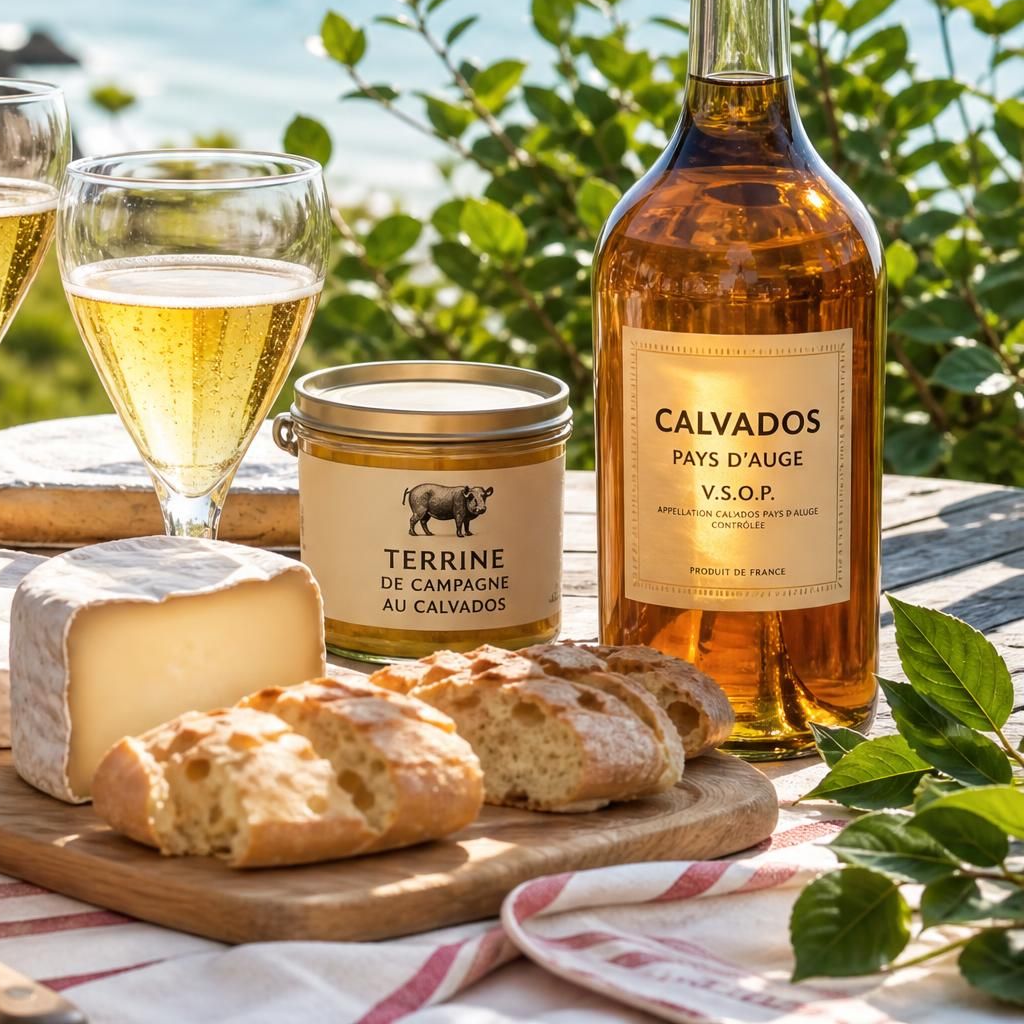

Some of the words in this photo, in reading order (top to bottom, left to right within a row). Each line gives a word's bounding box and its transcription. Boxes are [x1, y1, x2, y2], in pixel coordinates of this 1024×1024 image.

[655, 407, 821, 437] CALVADOS
[672, 449, 720, 468] PAYS
[727, 450, 804, 468] D'AUGE
[701, 484, 775, 502] V.S.O.P.
[657, 505, 713, 518] APPELLATION
[383, 548, 505, 571] TERRINE
[689, 566, 731, 576] PRODUIT
[733, 568, 747, 577] DE
[749, 567, 786, 577] FRANCE
[380, 576, 404, 591] DE
[410, 575, 509, 592] CAMPAGNE
[381, 598, 407, 613] AU
[413, 597, 506, 614] CALVADOS
